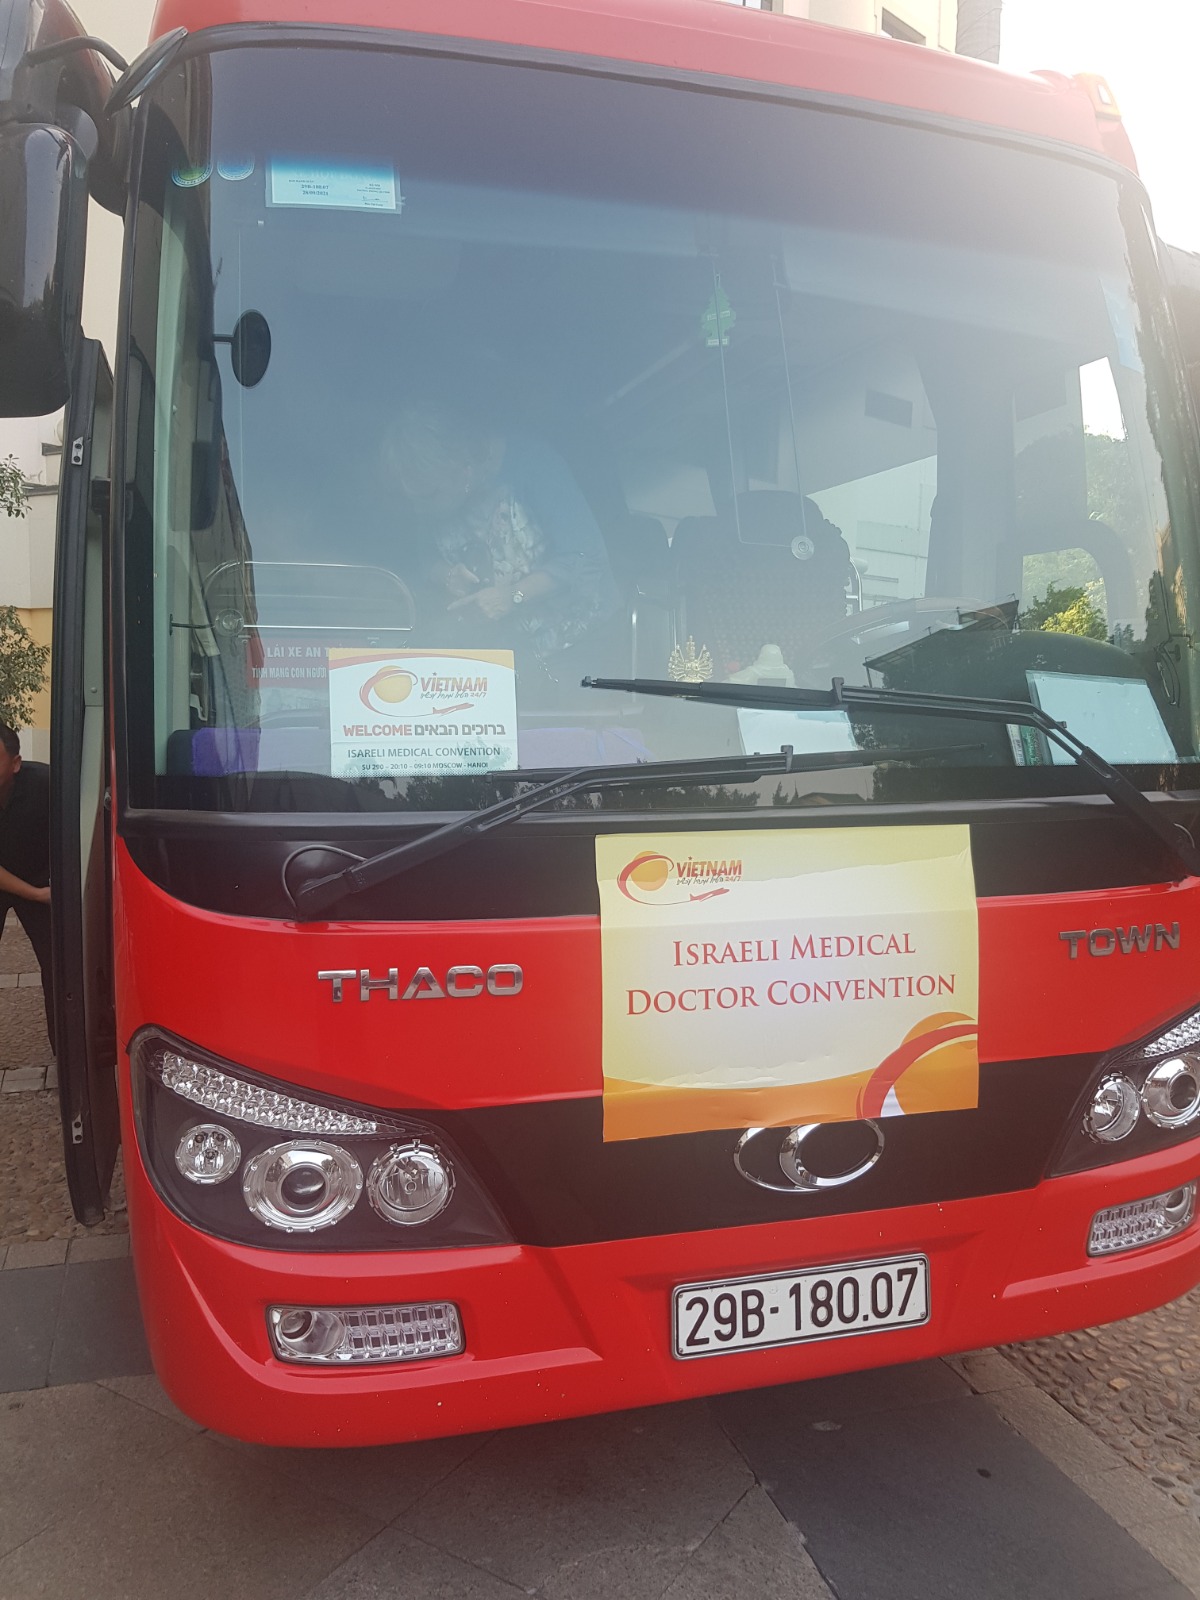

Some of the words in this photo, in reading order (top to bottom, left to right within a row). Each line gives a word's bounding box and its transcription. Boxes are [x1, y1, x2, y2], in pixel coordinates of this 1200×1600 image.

[288, 647, 302, 657] XE
[305, 647, 321, 657] AN
[291, 668, 305, 678] CON
[343, 724, 412, 737] WELCOME
[414, 723, 459, 736] הבאים
[461, 723, 506, 736] ברוכים
[347, 748, 385, 758] ISARELI
[387, 748, 433, 757] MEDICAL
[435, 747, 501, 757] CONVENTION
[1059, 921, 1180, 959] TOWN
[317, 963, 524, 1003] THACO
[685, 1267, 918, 1347] 29B-180.07
